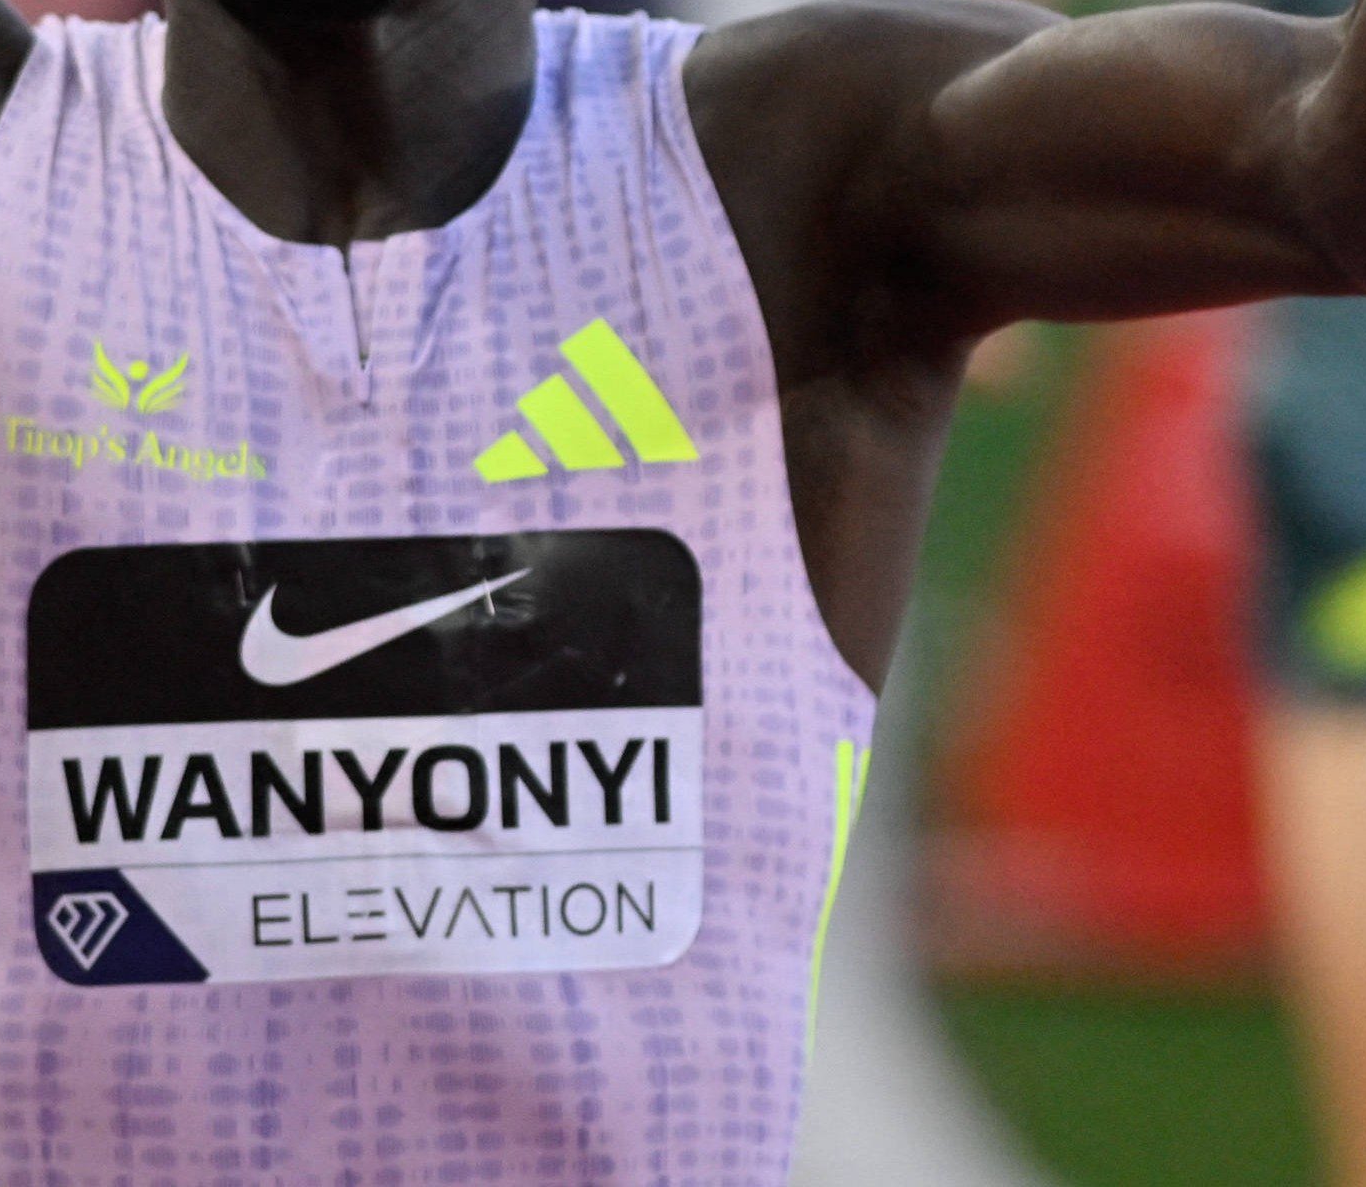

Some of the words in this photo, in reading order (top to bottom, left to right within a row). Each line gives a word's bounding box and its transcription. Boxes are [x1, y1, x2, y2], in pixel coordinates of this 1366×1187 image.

[137, 429, 267, 482] Angels
[61, 737, 671, 844] WANYONYI
[252, 881, 656, 947] ELEVATION
